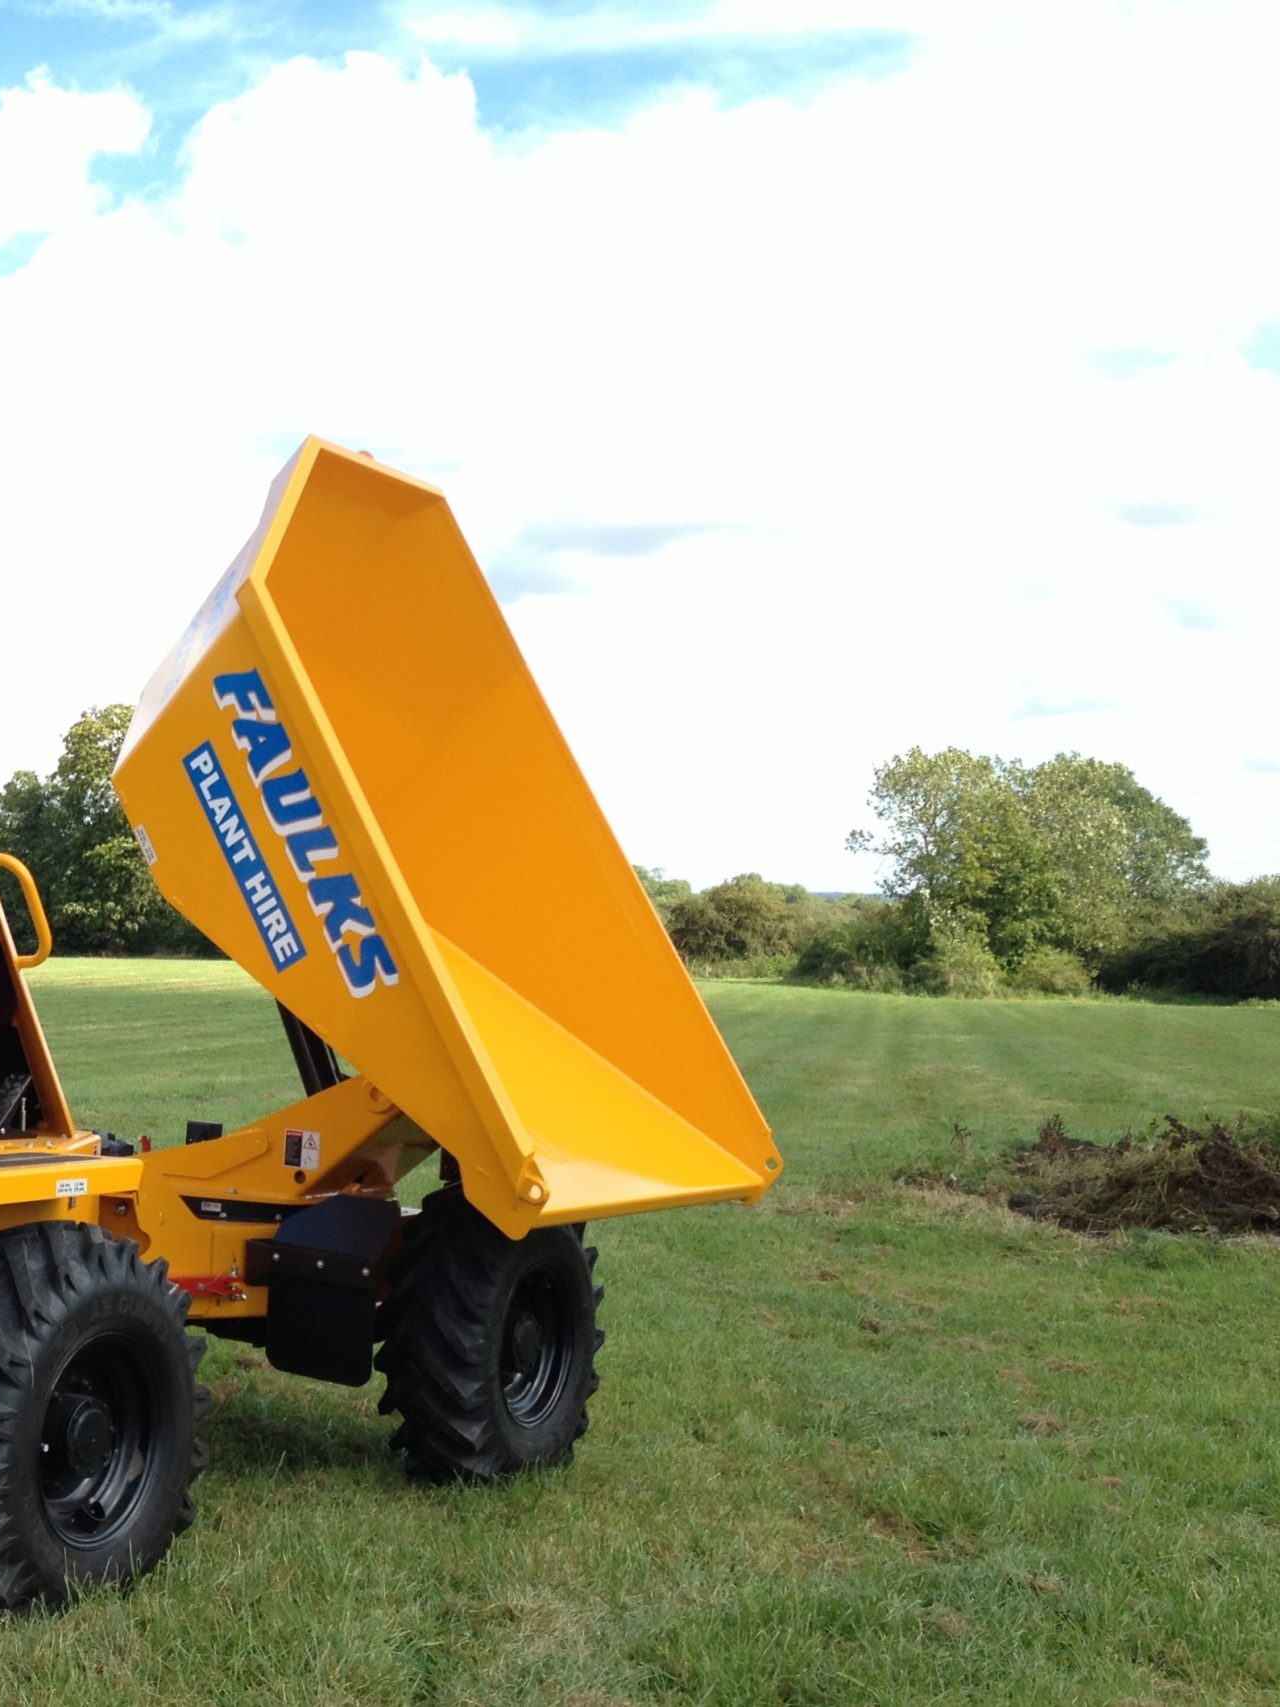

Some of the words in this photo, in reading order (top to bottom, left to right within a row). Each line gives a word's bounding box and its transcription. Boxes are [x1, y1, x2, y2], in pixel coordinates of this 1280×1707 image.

[190, 750, 256, 865] PLANT
[245, 871, 299, 963] HIRE
[213, 668, 399, 998] FAULKS
